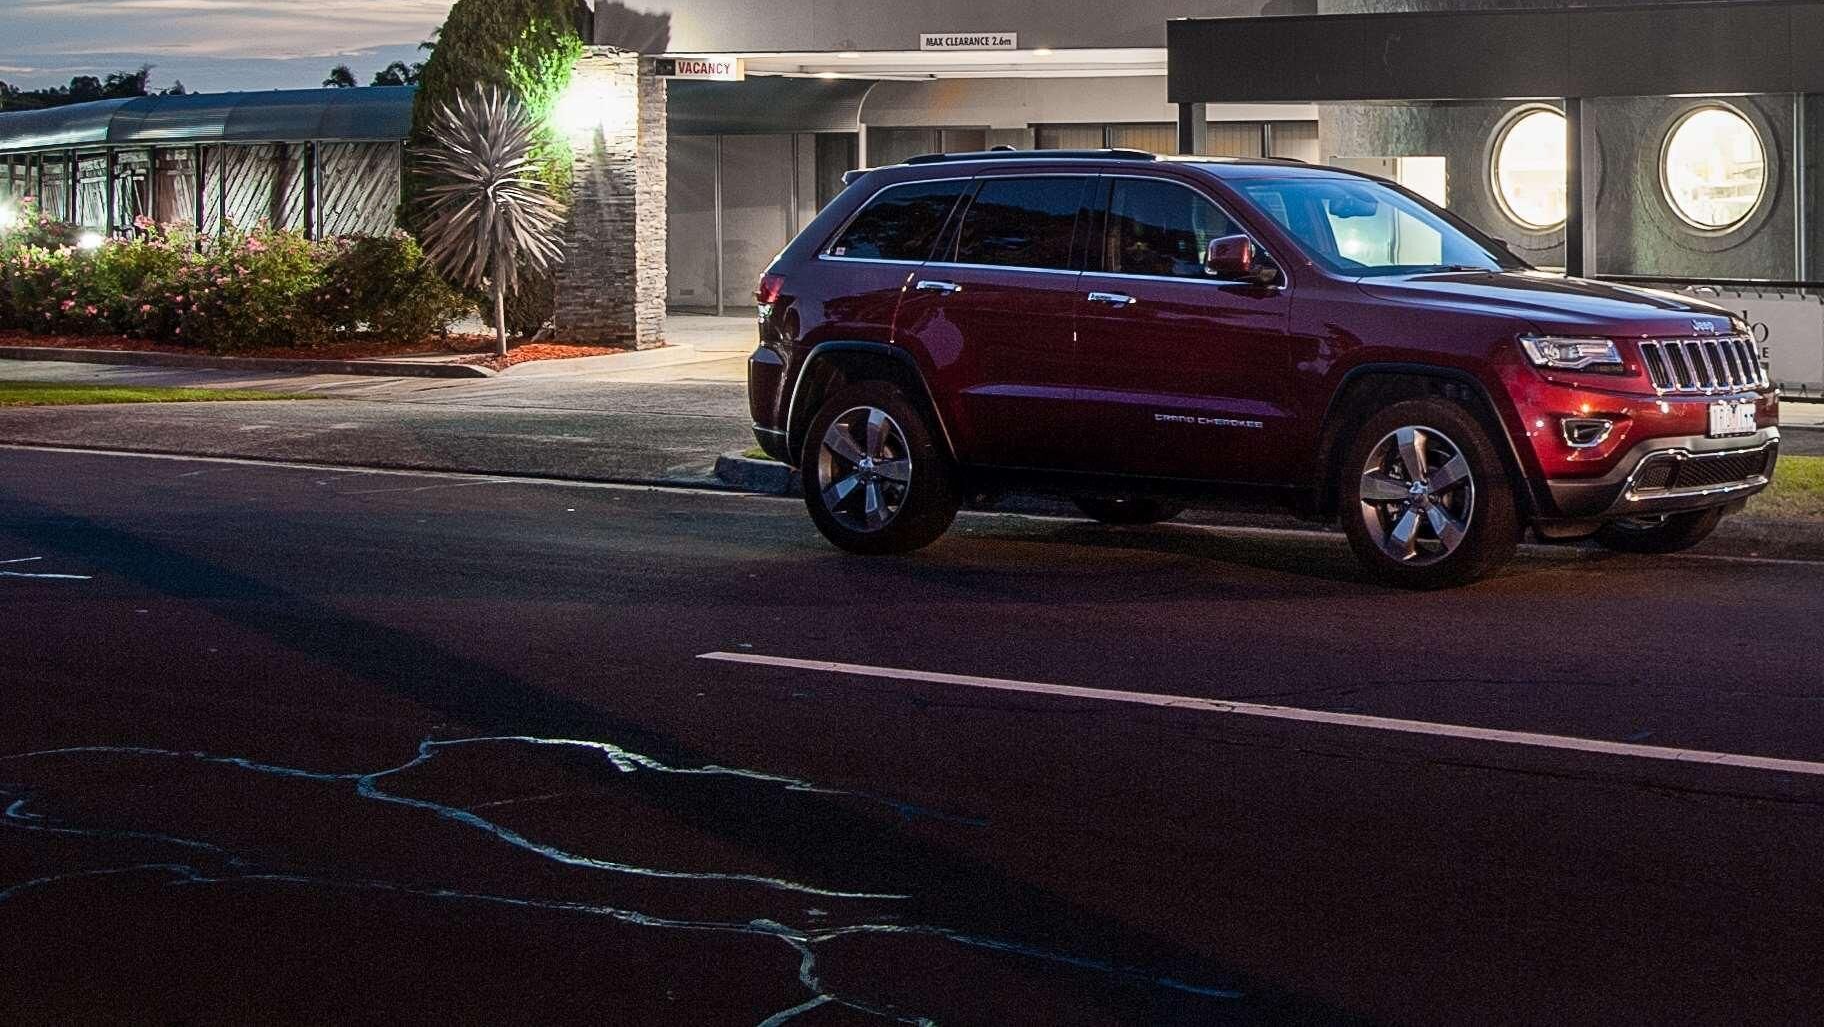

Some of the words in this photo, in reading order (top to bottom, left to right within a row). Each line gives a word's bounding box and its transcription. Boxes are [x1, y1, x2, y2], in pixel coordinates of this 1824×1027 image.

[926, 37, 943, 46] MAX
[945, 36, 990, 46] CLEARANCE
[992, 36, 1011, 46] 2.6m
[678, 61, 731, 75] VACANCY
[1692, 320, 1714, 333] Jeep
[1154, 413, 1195, 423] GRAND
[1197, 417, 1263, 428] CHEROKEE
